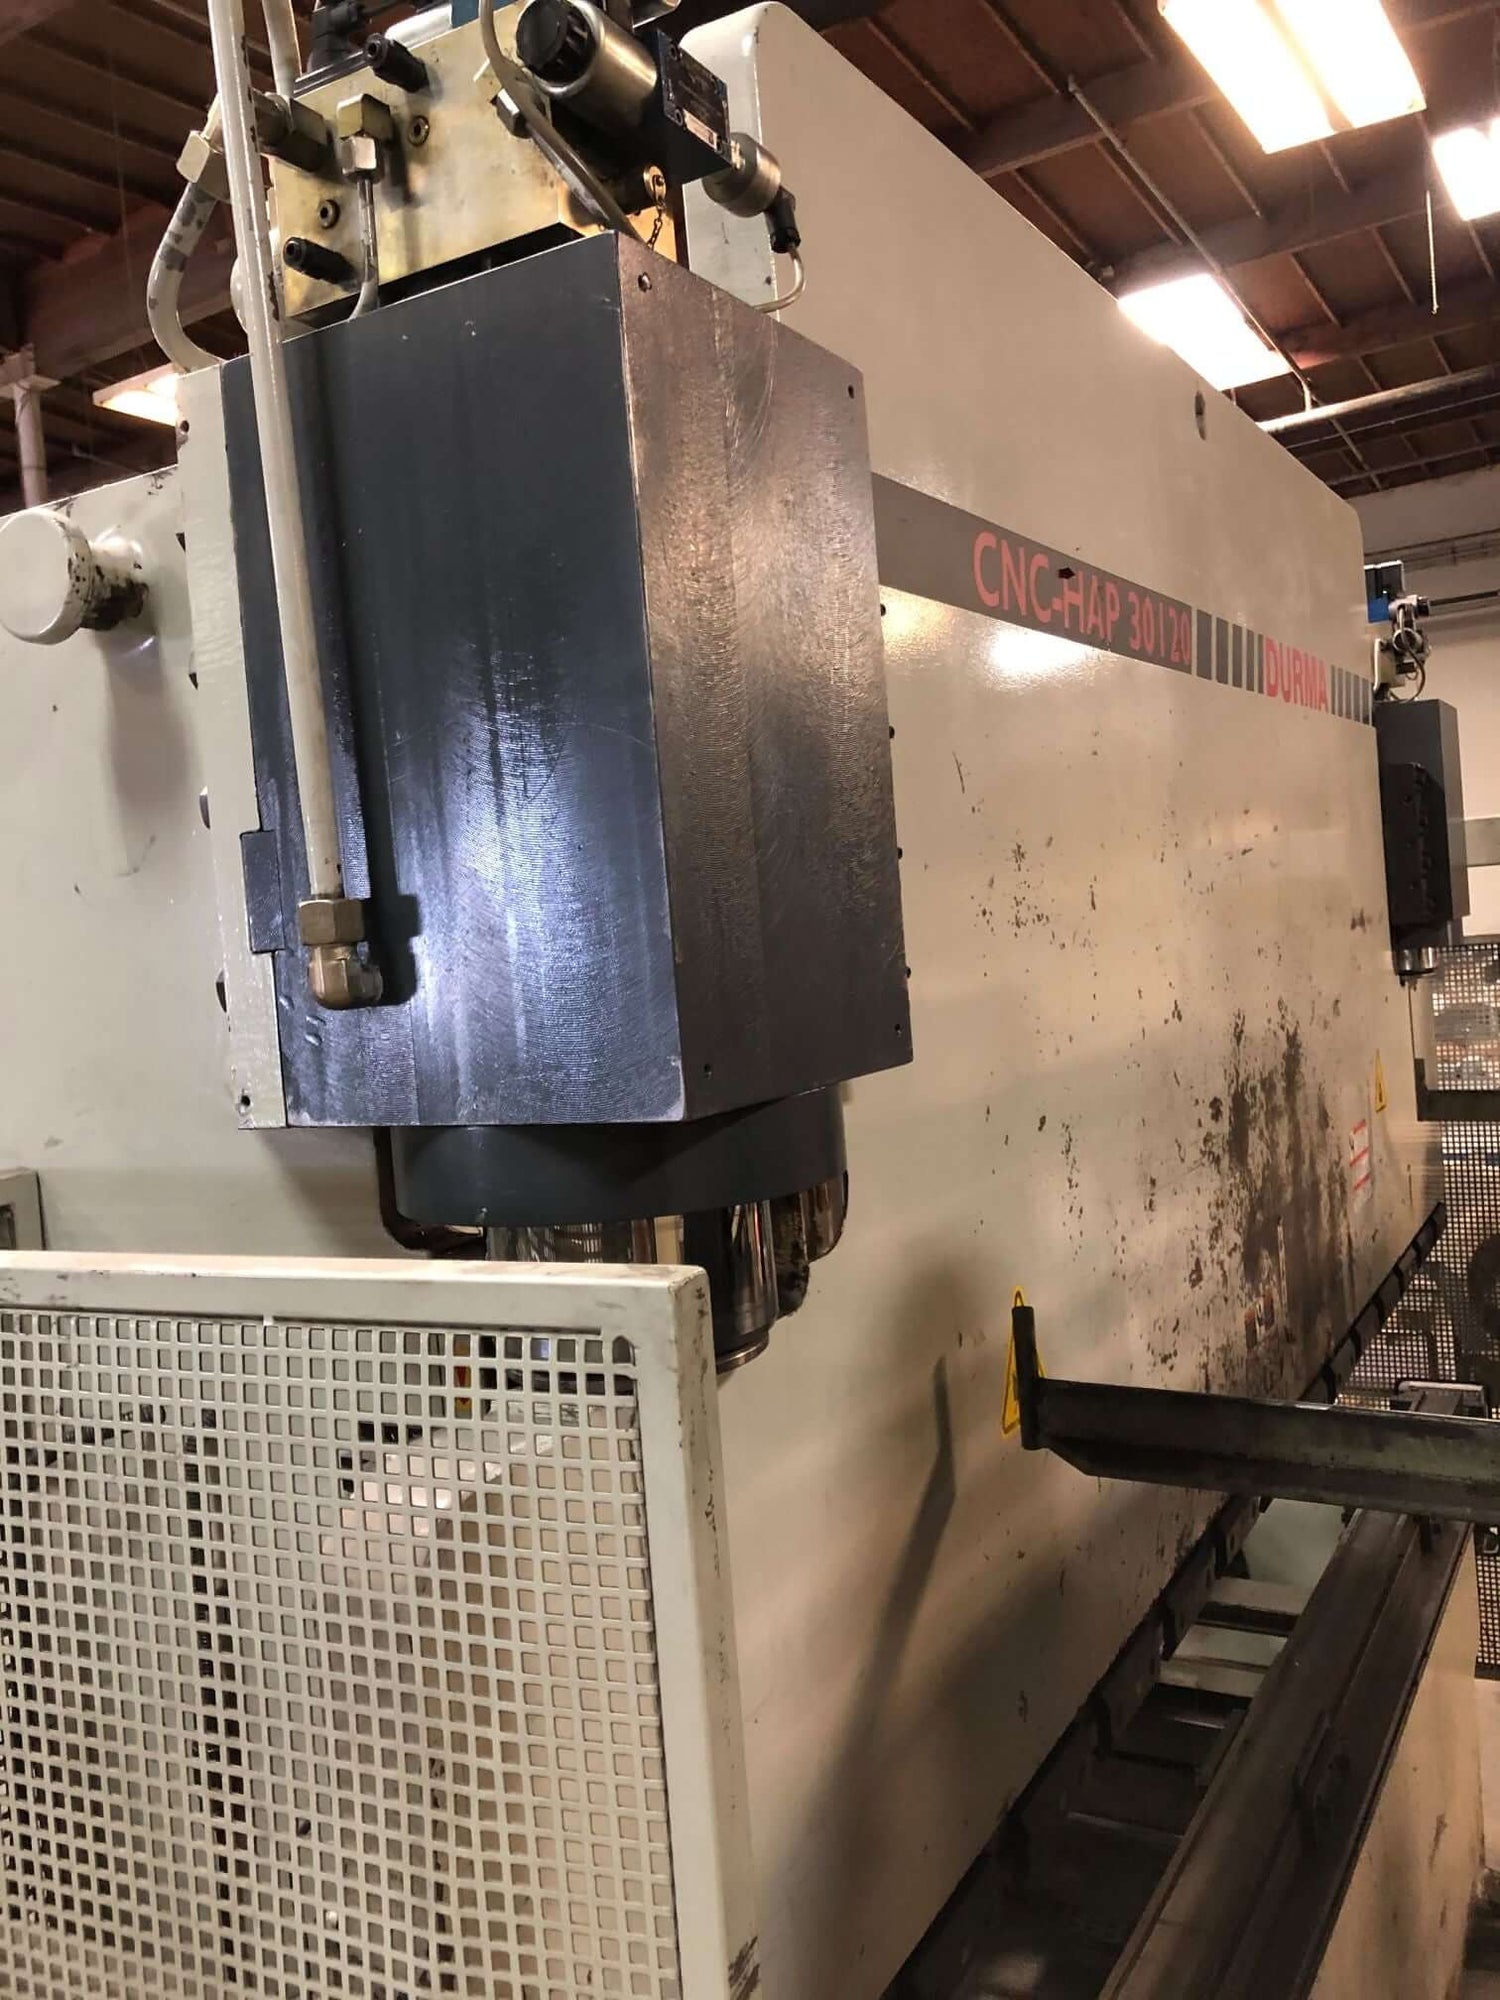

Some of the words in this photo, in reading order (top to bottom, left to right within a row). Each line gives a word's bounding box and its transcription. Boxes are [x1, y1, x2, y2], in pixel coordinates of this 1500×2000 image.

[973, 530, 1121, 643] CNC-HAP
[1127, 591, 1192, 665] 30120
[1264, 635, 1329, 714] DURMA
